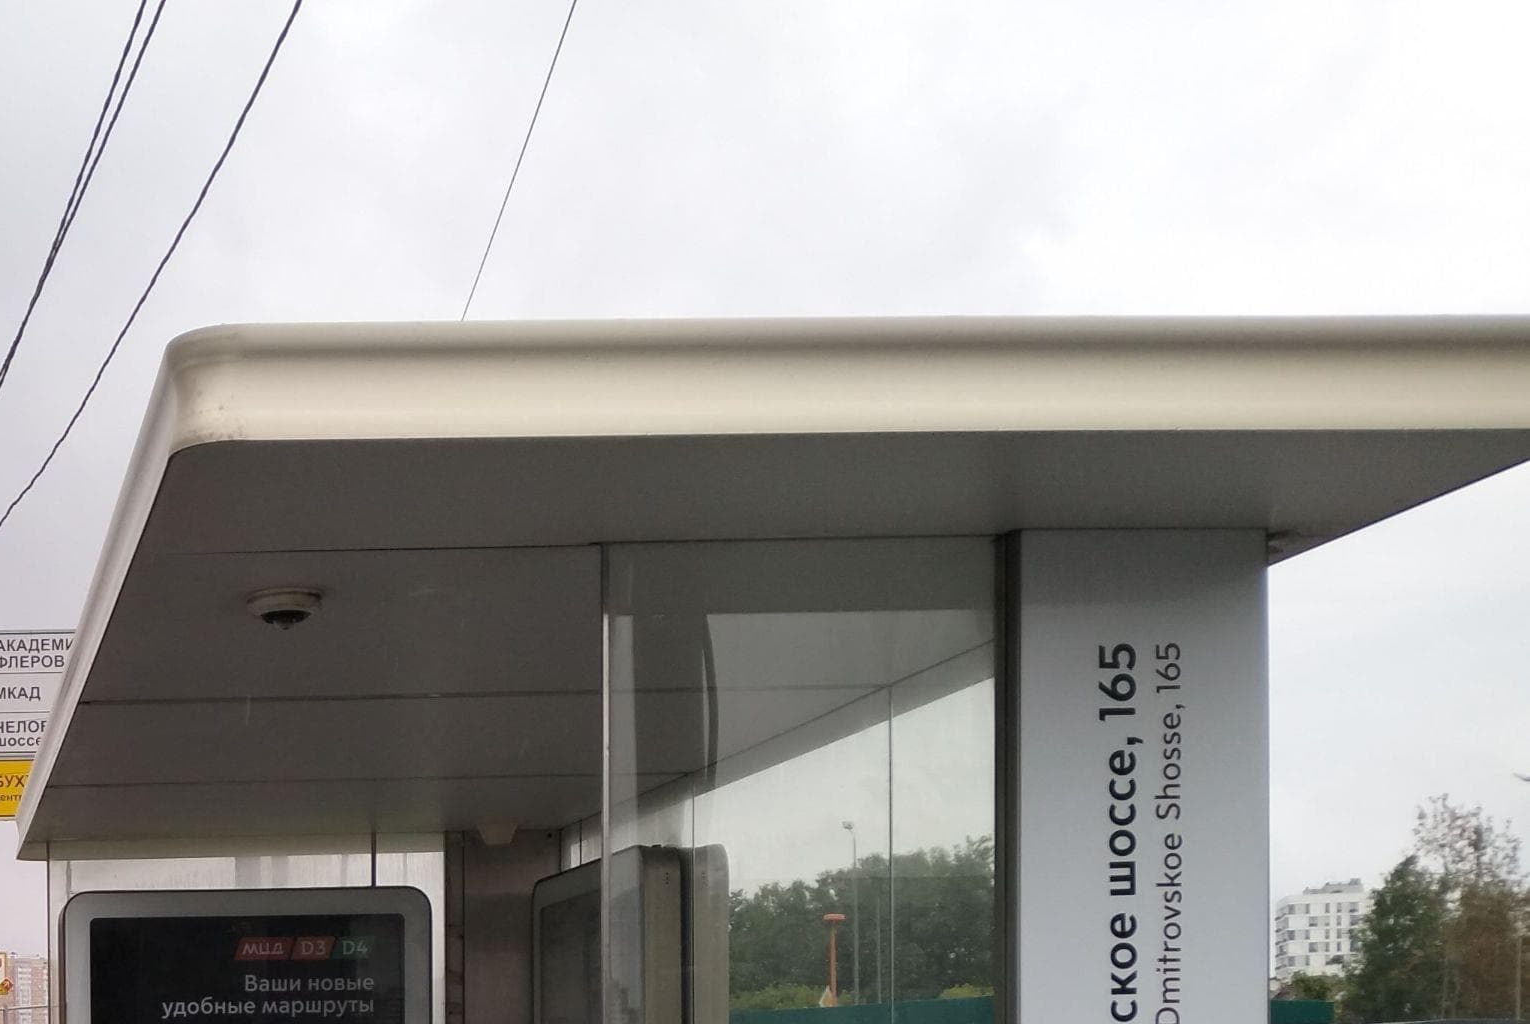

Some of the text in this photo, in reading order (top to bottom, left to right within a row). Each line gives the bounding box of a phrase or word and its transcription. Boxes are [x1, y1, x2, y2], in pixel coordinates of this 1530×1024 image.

[1099, 642, 1137, 722] 165
[1156, 642, 1182, 695] 165
[1155, 704, 1185, 821] Shosse,
[1108, 736, 1144, 897] шоссе,
[301, 940, 327, 955] D3
[342, 940, 368, 955] D4
[161, 996, 375, 1020] удобные маршруты
[244, 974, 375, 993] Ваши новые
